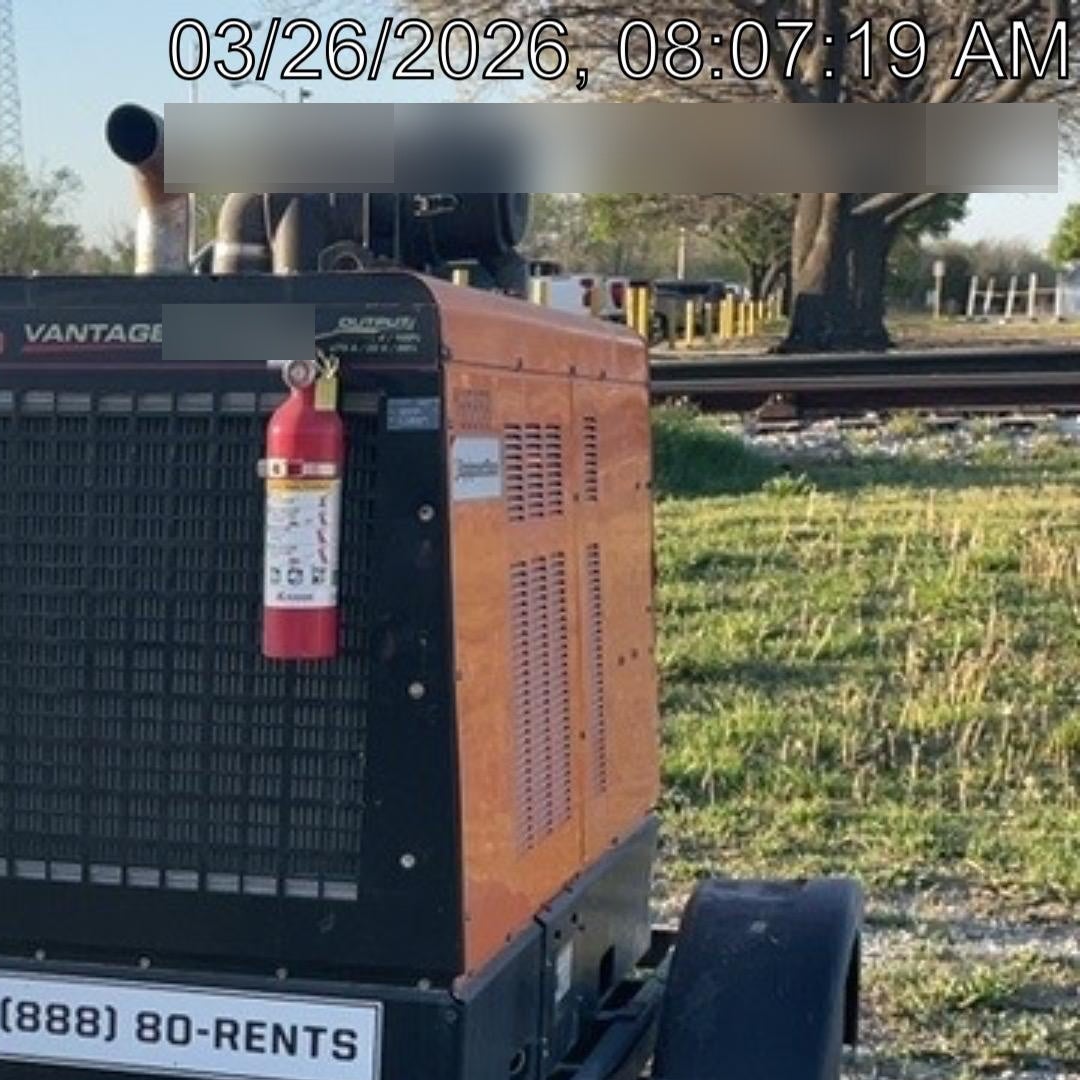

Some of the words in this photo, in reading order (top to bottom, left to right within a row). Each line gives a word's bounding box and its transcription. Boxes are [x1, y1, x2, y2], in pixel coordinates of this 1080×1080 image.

[24, 323, 162, 343] VANTAGE
[0, 996, 116, 1042] (888)
[135, 1011, 358, 1061] 80-RENTS
